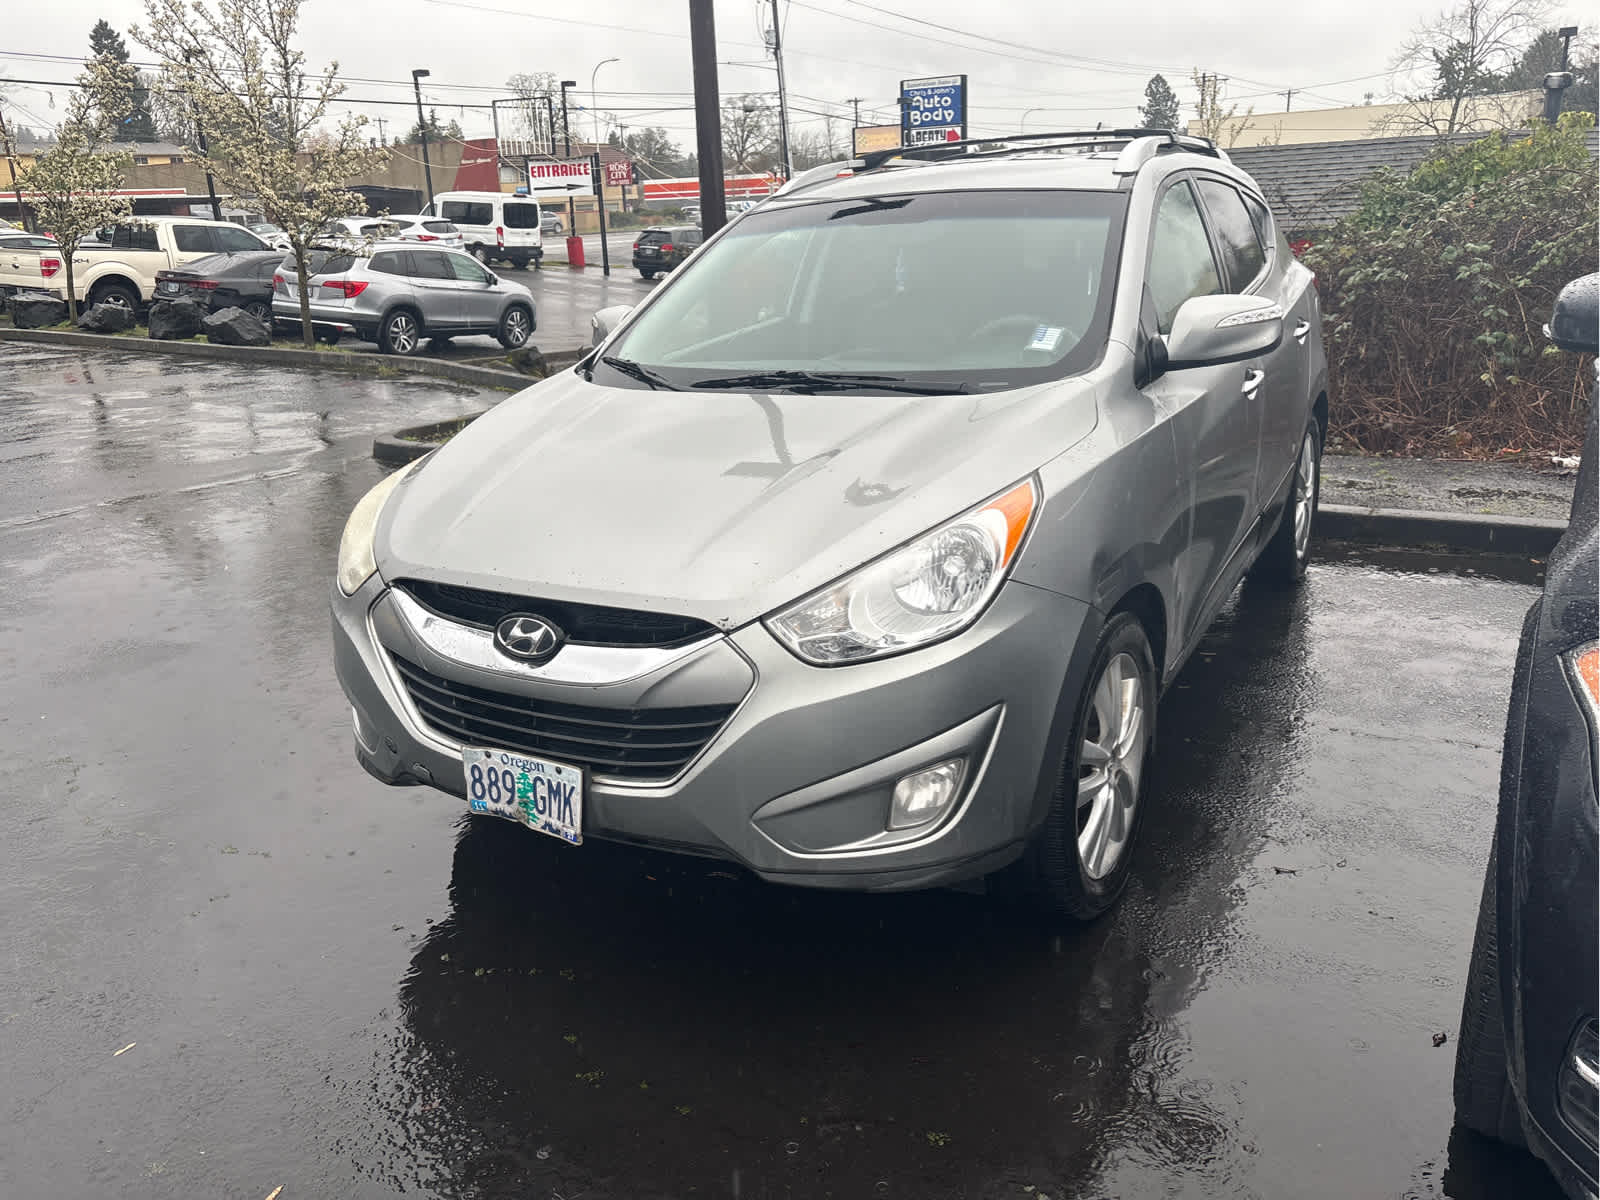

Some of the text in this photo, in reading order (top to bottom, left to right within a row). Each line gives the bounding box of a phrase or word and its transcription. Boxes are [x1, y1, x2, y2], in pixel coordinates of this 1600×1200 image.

[912, 95, 952, 111] Auto
[910, 108, 955, 126] Body
[530, 163, 591, 178] ENTRANCE
[609, 162, 629, 172] ROSE
[610, 171, 628, 179] CITY
[500, 753, 545, 773] Oregon
[470, 764, 576, 827] 889 GMK
